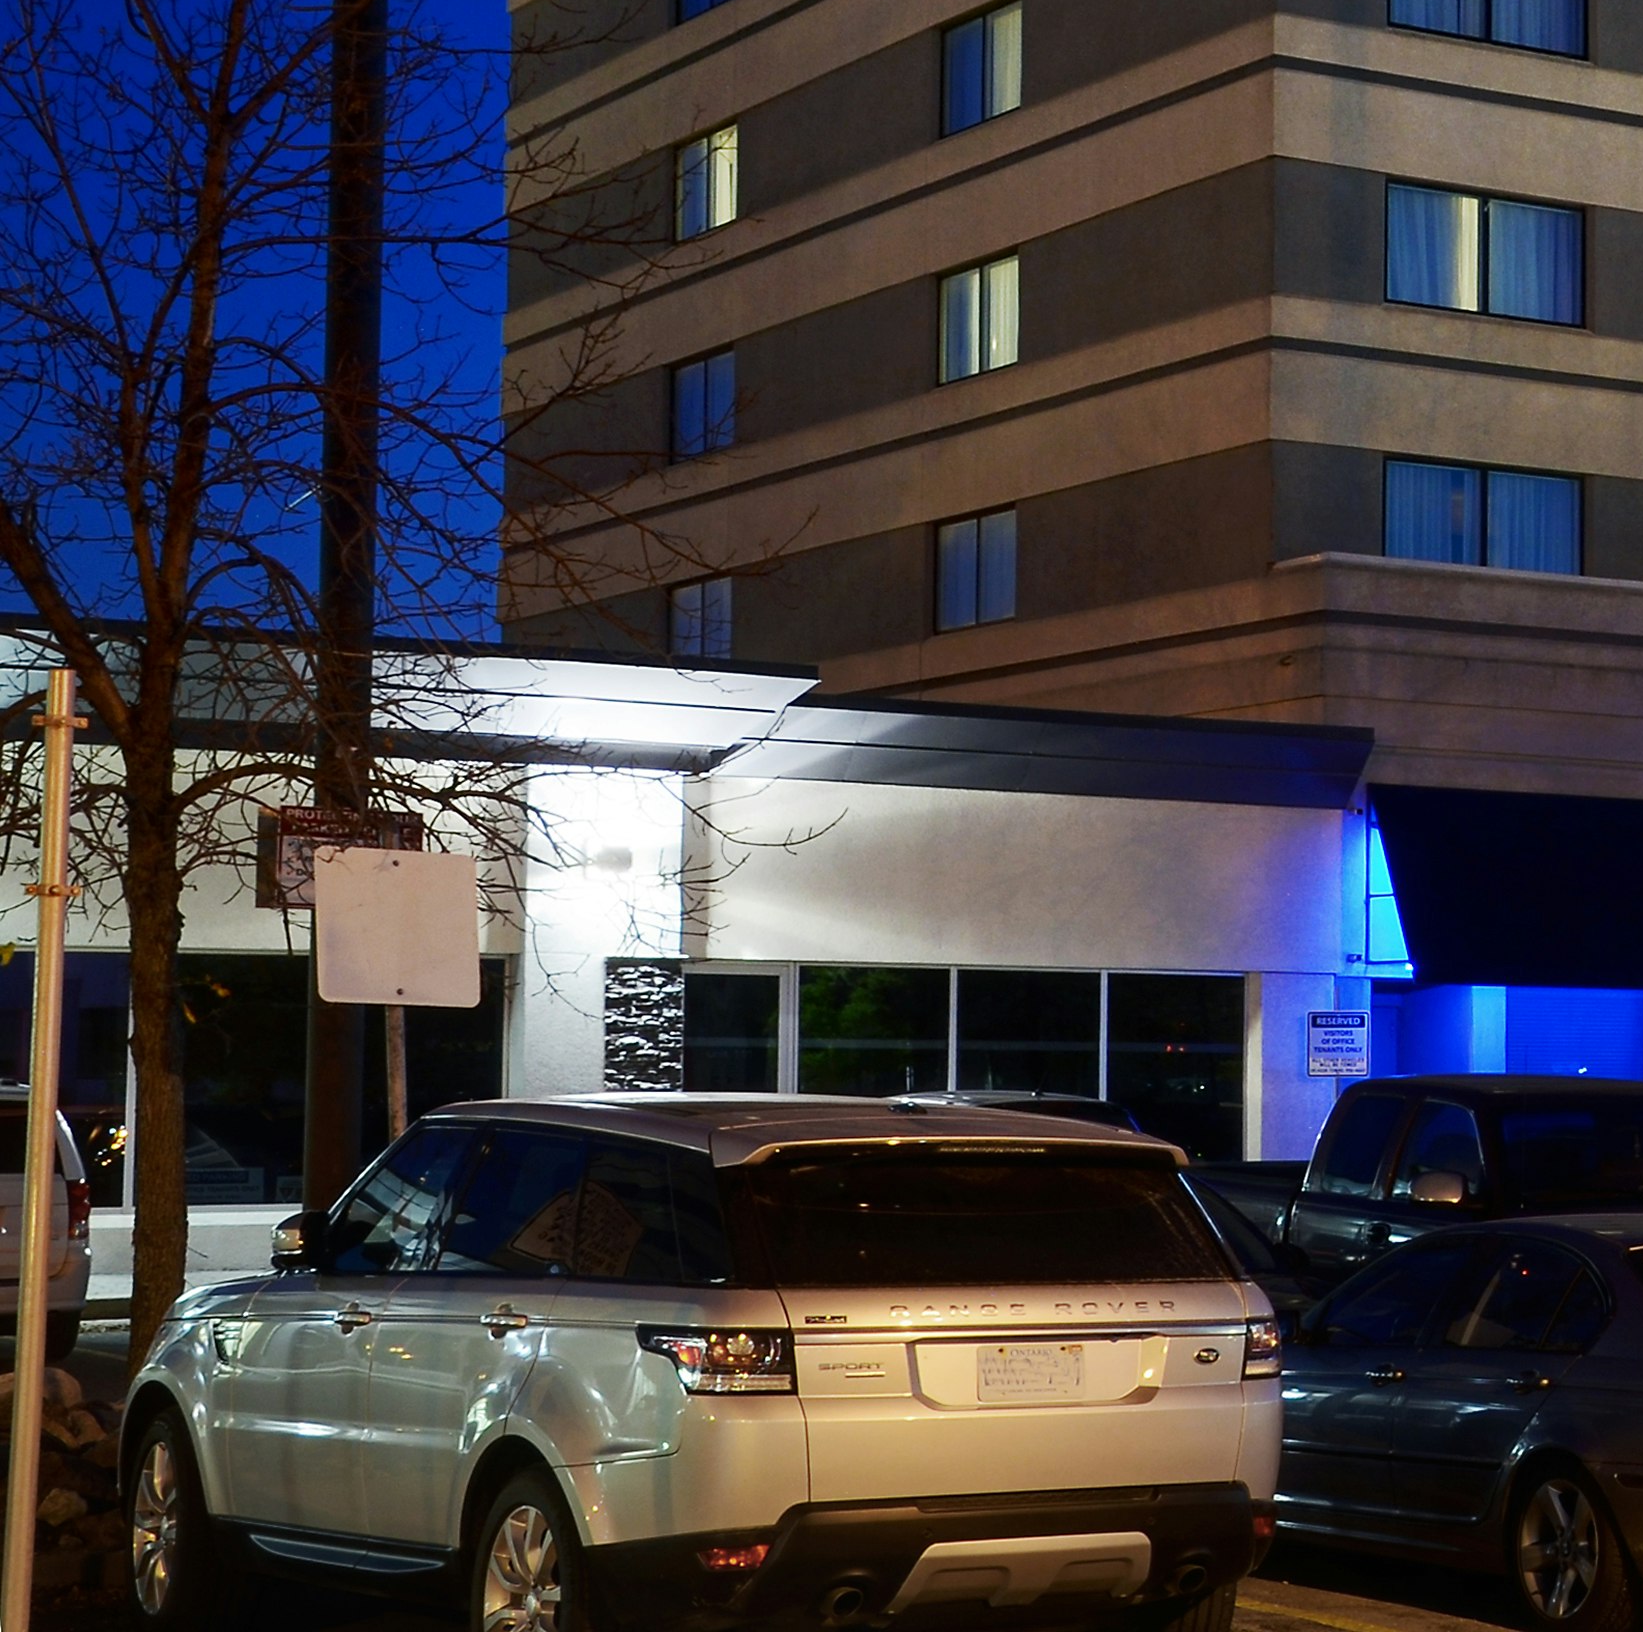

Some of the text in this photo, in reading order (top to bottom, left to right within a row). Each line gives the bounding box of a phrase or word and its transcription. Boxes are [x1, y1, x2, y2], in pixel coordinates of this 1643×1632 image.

[1316, 1017, 1361, 1025] RESERVED
[889, 1300, 1177, 1319] RANGE ROVER
[1010, 1348, 1053, 1357] ONTARIO
[818, 1362, 884, 1371] SPORT
